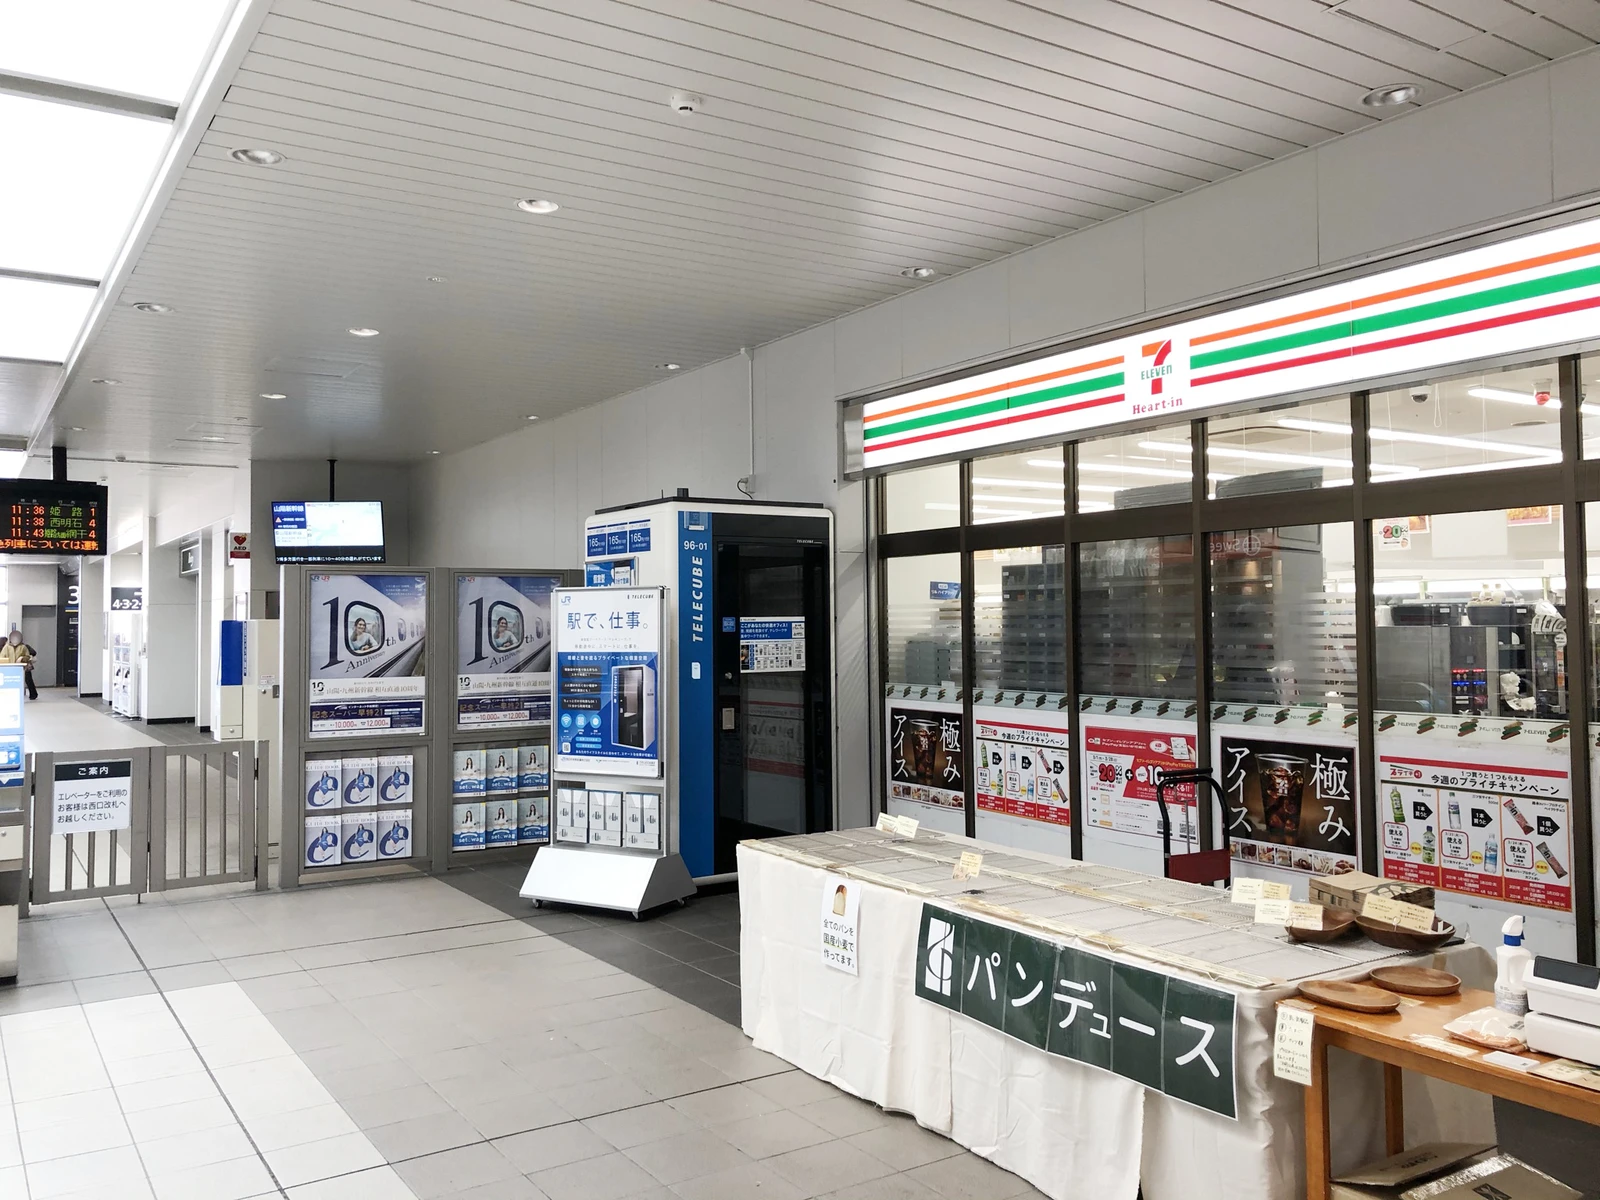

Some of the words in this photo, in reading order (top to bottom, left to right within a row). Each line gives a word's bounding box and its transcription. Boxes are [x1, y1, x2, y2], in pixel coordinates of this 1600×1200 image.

[1132, 396, 1183, 414] Heart-in
[90, 508, 96, 517] 1
[11, 516, 45, 526] 11:38
[50, 517, 82, 528] 西明石
[88, 518, 96, 528] 4
[11, 528, 44, 538] 11:43
[88, 530, 96, 539] 4
[684, 540, 708, 550] 96-01
[561, 596, 572, 604] JR
[692, 556, 704, 642] TELECUBE
[567, 611, 648, 630] 駅で、仕事。
[893, 714, 909, 778] アイス
[940, 718, 961, 782] 極み
[78, 766, 108, 776] ご案内
[58, 789, 128, 800] エレベーターをご利用の
[1226, 746, 1252, 832] アイス
[1308, 752, 1351, 842] 極み
[58, 800, 126, 812] お客様は西口改札へ
[57, 812, 115, 824] お越しください。
[1415, 810, 1427, 818] 買うと
[1446, 836, 1462, 844] 使える
[1510, 846, 1526, 854] 使える
[823, 918, 854, 937] 全てのパンを
[823, 932, 854, 952] 国産小麦で
[824, 948, 855, 968] 作ってます。
[966, 951, 1221, 1079] パンデュース
